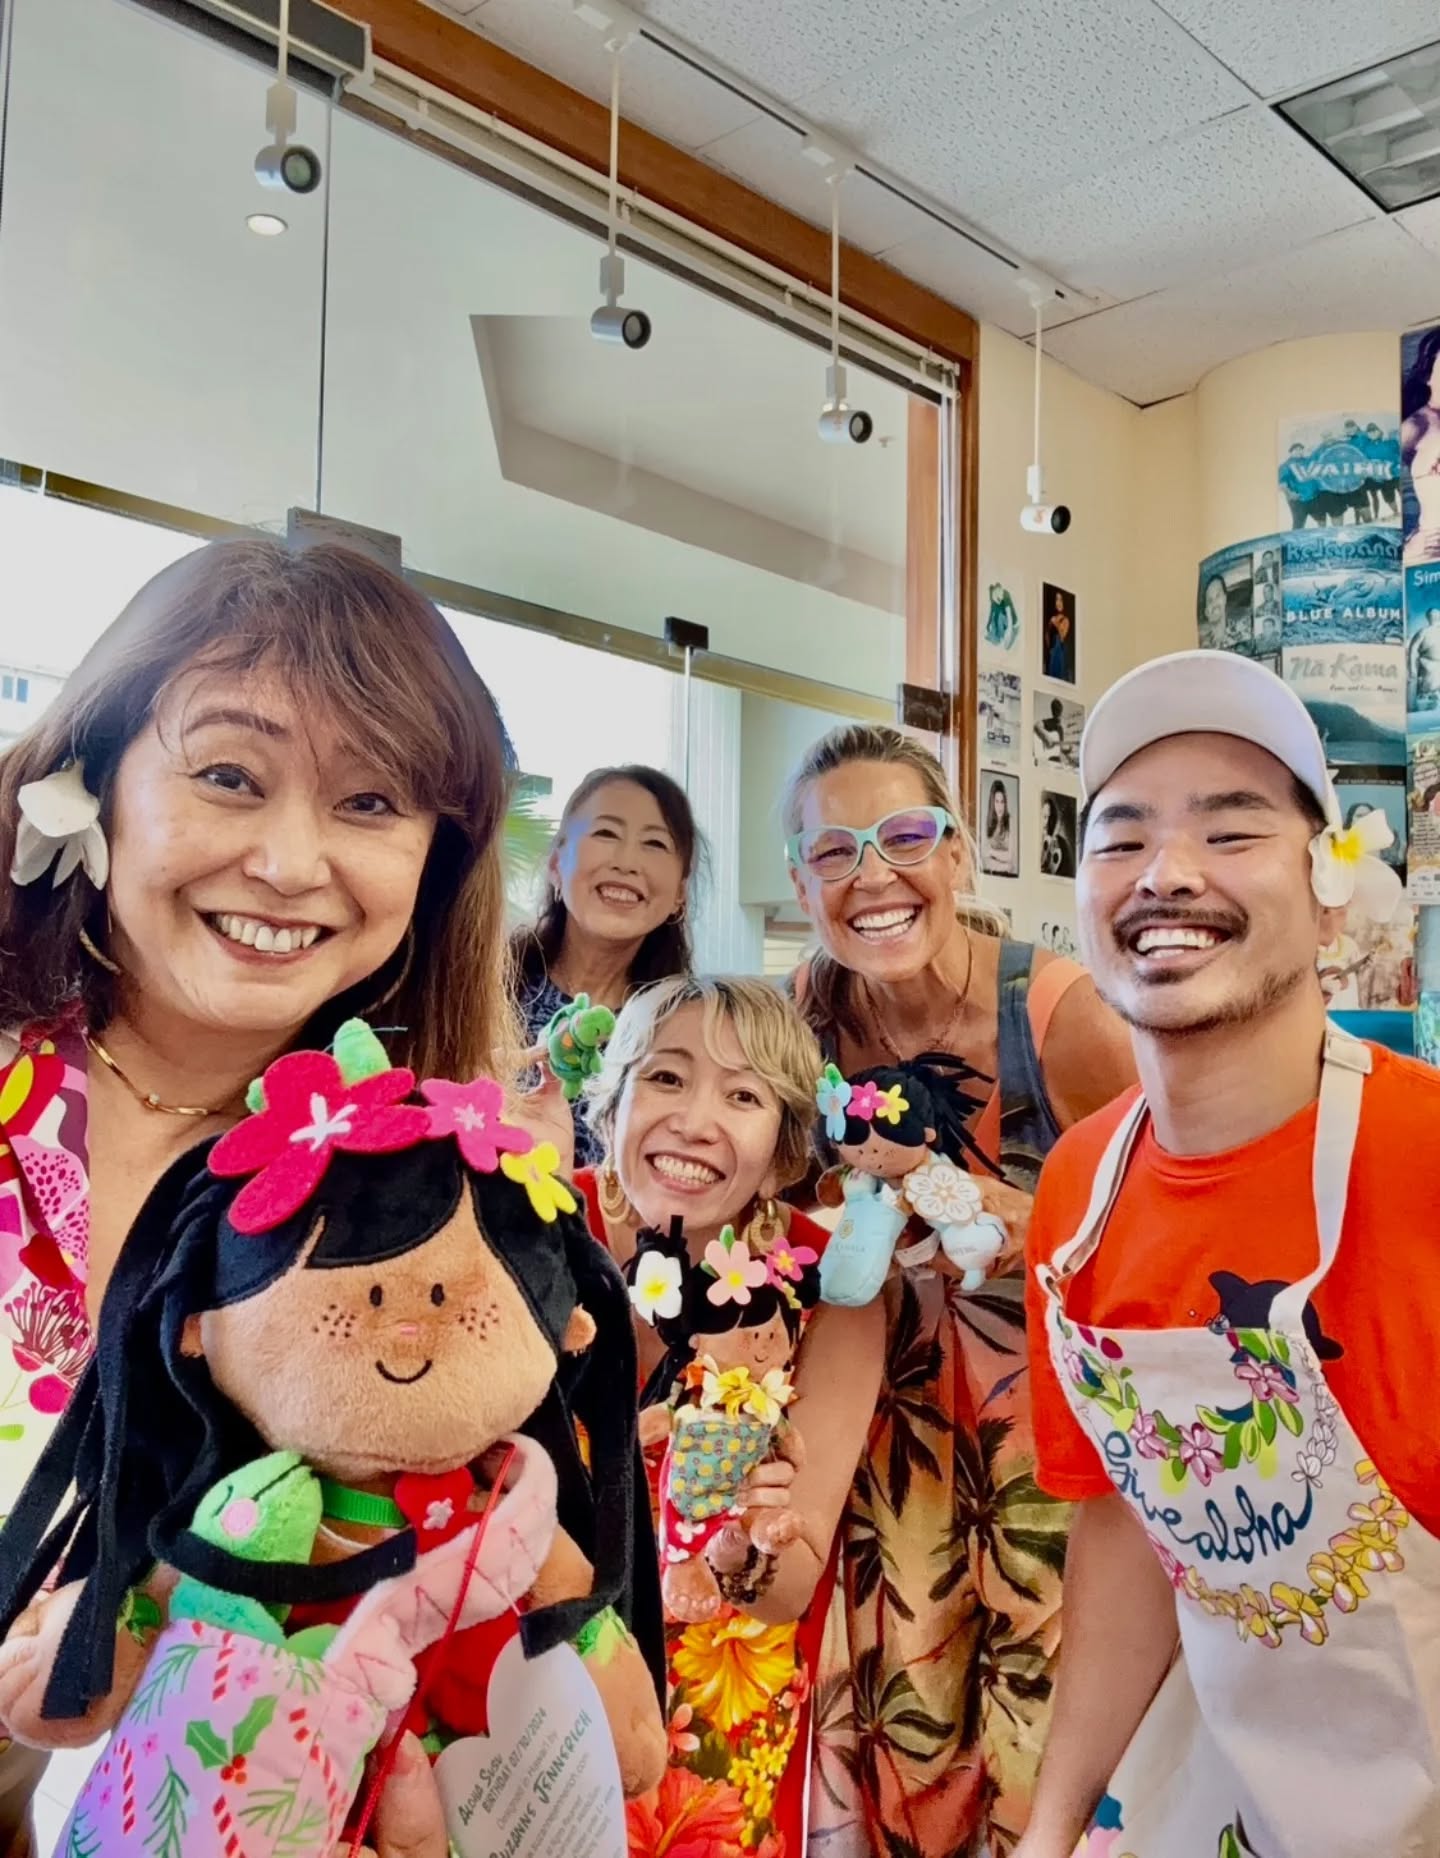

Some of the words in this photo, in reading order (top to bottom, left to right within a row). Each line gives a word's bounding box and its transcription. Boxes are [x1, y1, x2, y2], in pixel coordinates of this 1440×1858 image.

[1286, 608, 1333, 623] BLUE
[1342, 606, 1401, 620] ALBUM
[1195, 1482, 1312, 1564] aloha
[533, 1710, 592, 1804] JENNERICH
[482, 1766, 514, 1814] BIRTHDAY
